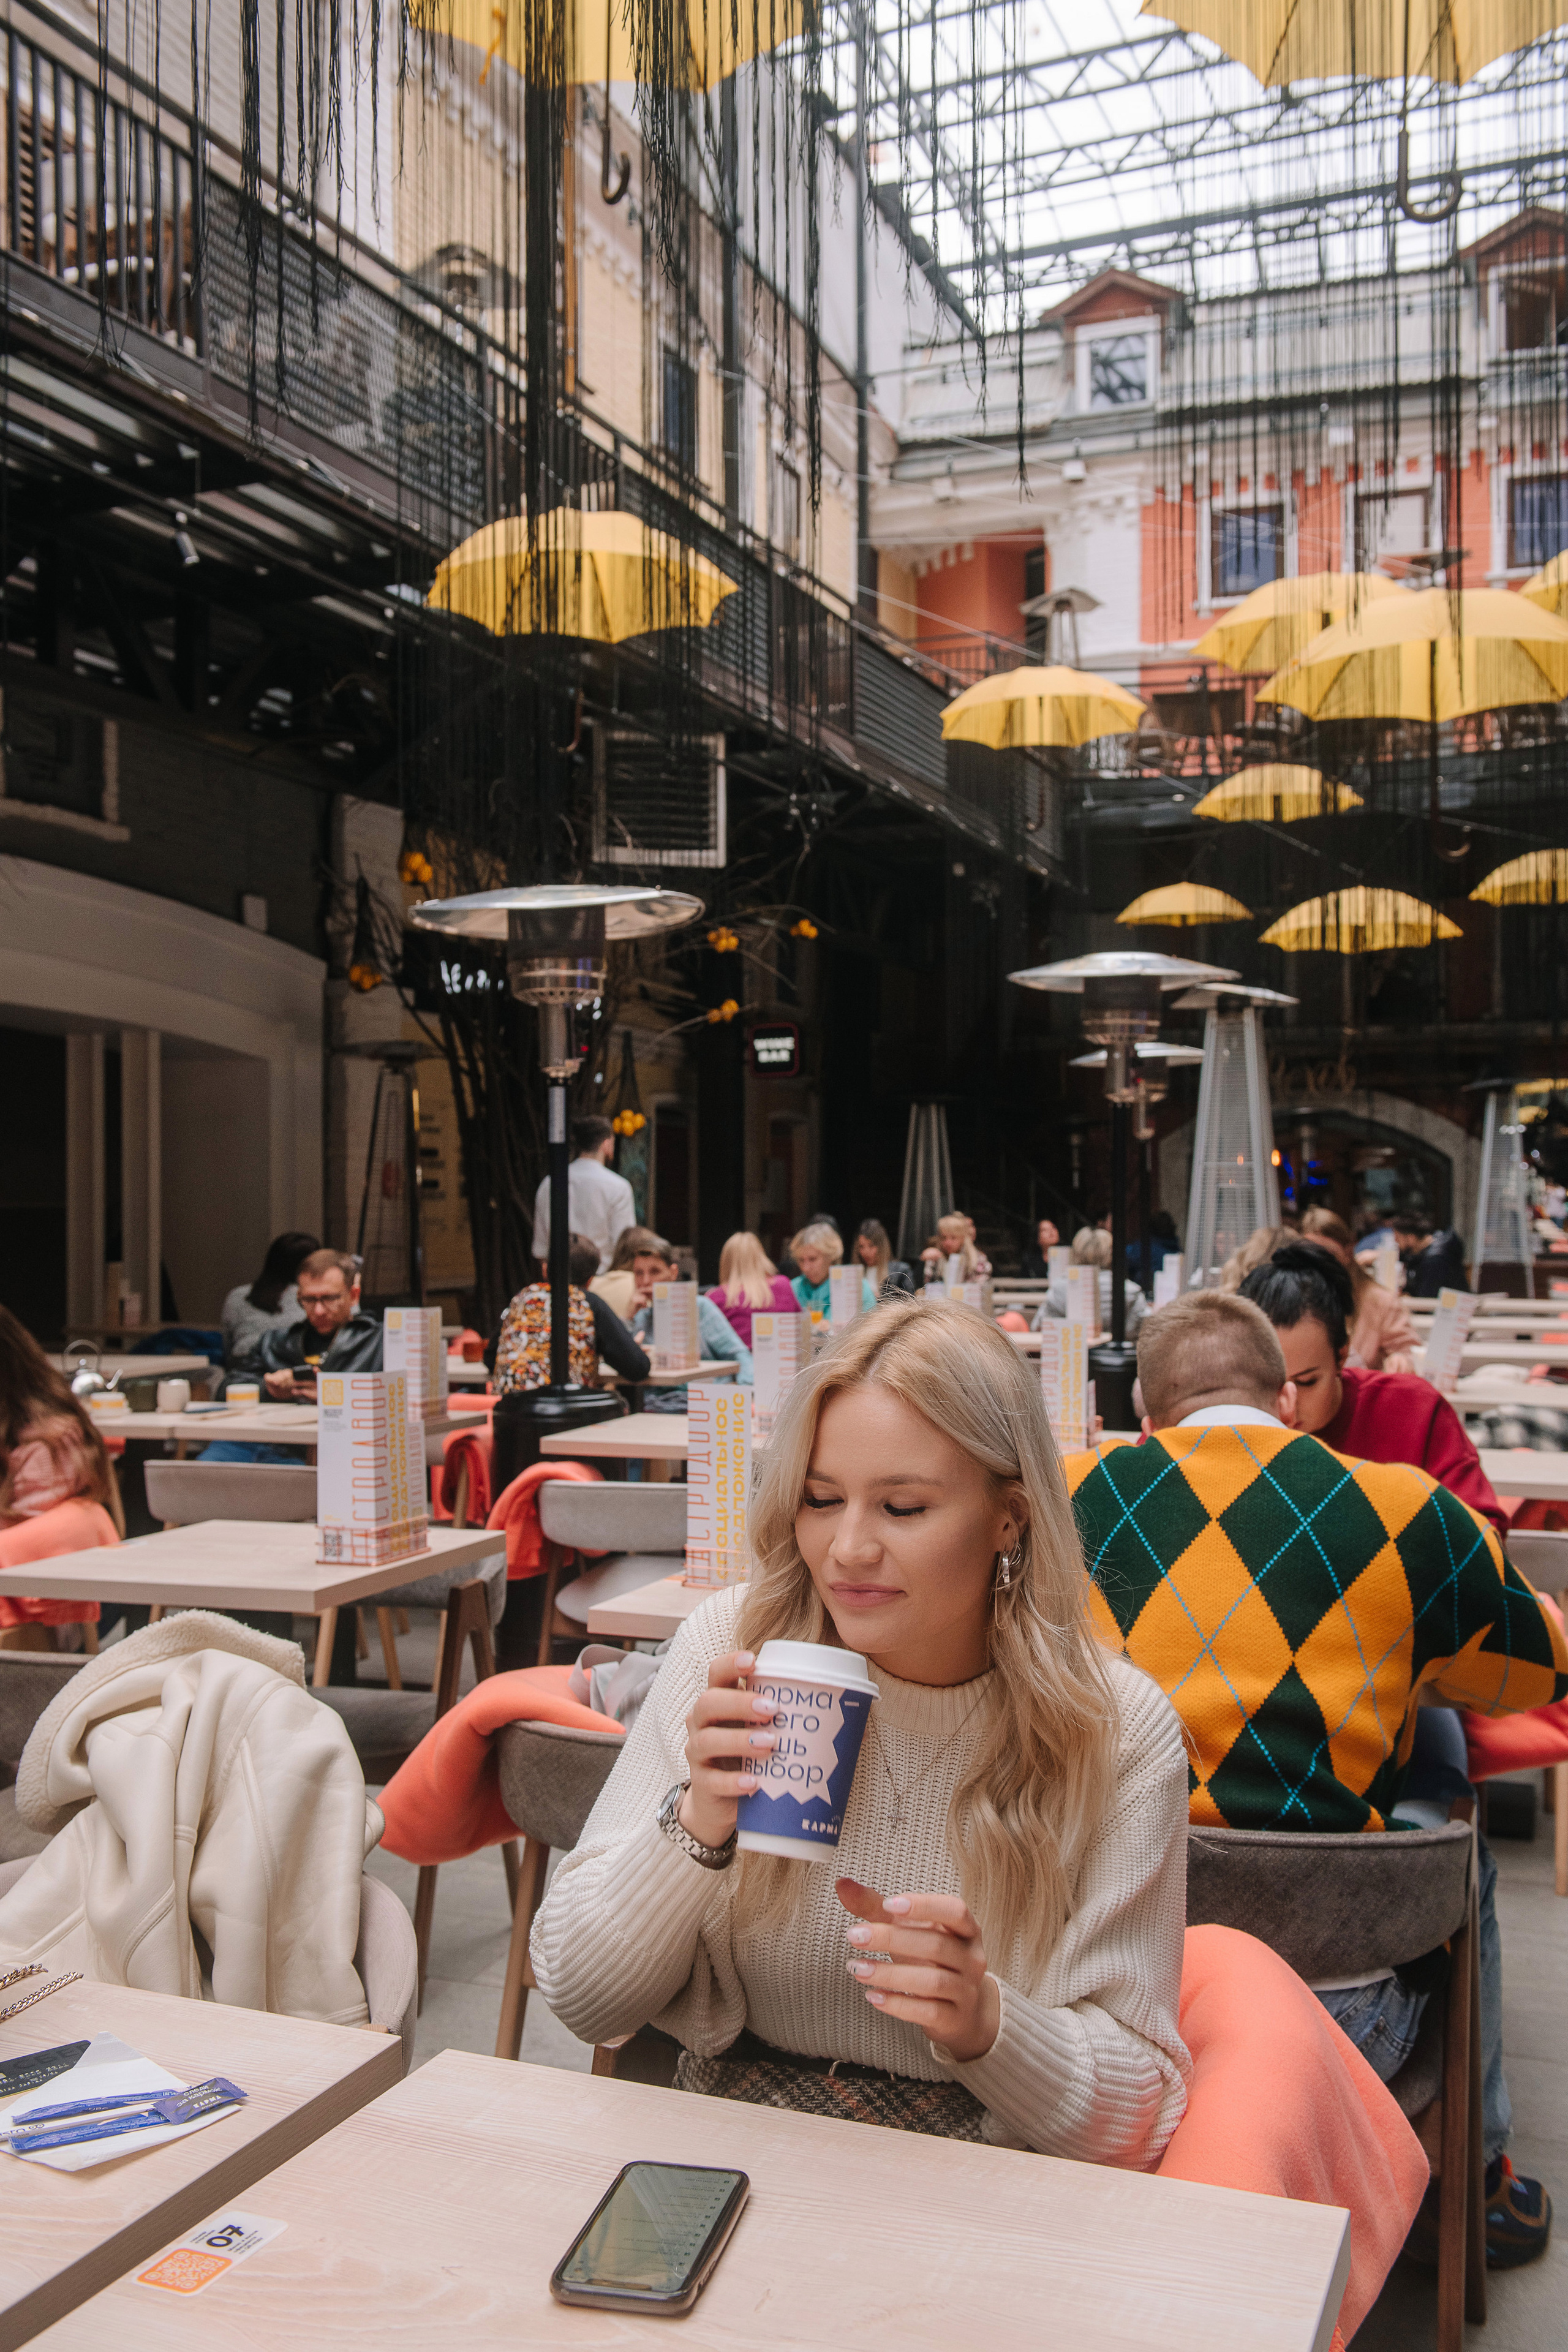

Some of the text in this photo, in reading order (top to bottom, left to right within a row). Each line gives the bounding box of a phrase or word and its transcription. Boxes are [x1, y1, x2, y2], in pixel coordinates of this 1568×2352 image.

[758, 1049, 790, 1063] BAR
[744, 1754, 823, 1789] выбор
[184, 2085, 209, 2096] следи
[176, 2098, 189, 2108] за
[193, 2095, 222, 2109] КАРМА
[206, 2225, 244, 2247] 07
